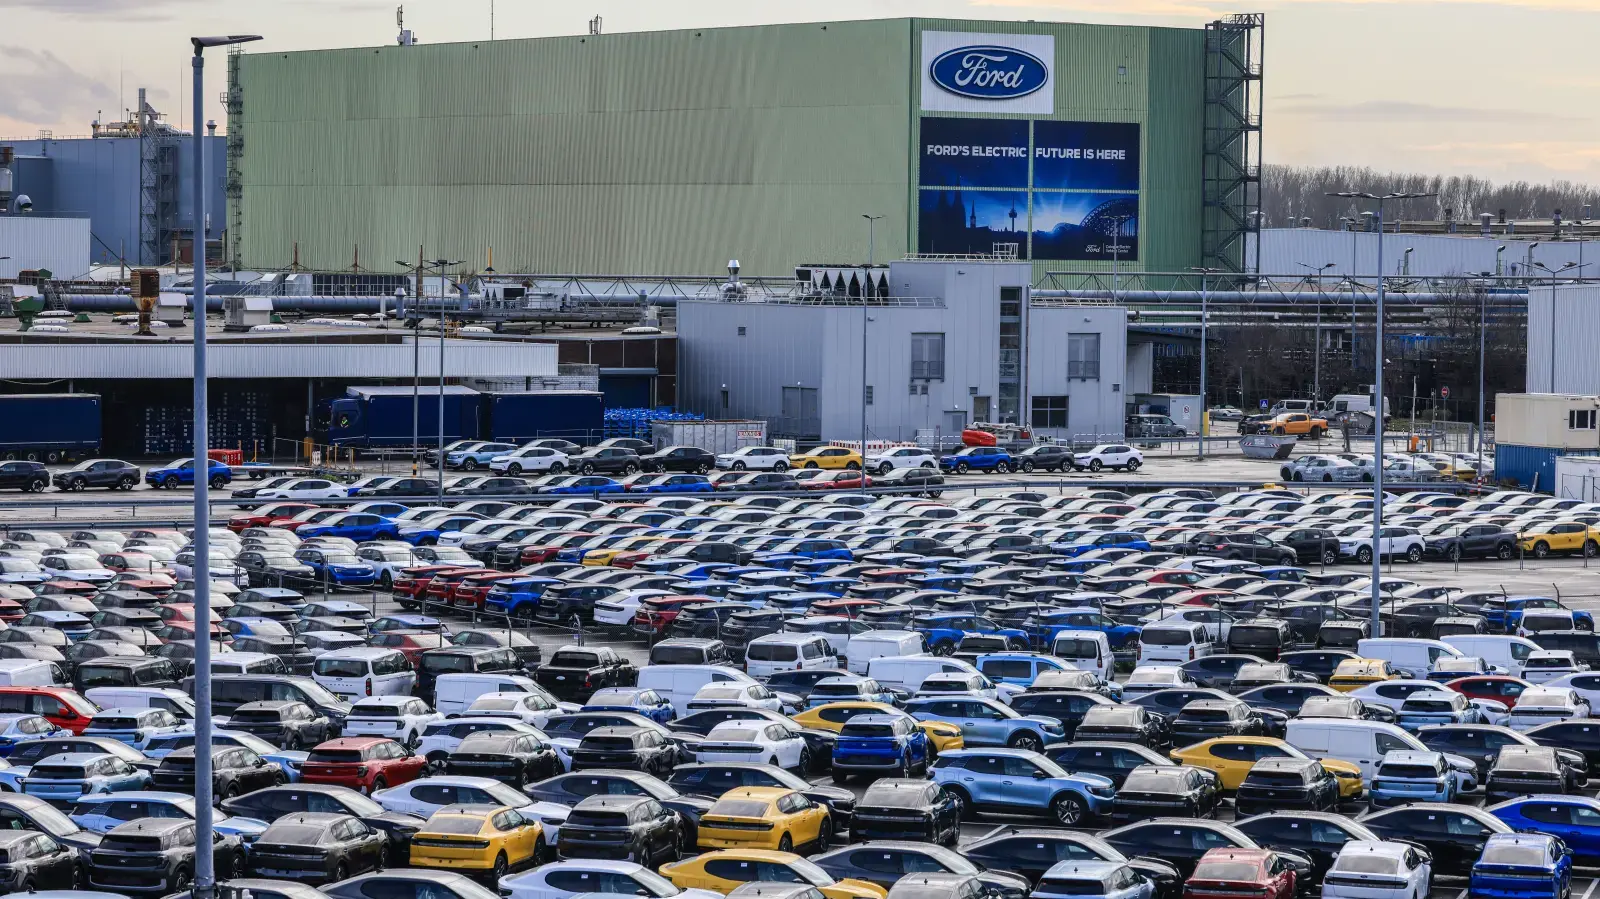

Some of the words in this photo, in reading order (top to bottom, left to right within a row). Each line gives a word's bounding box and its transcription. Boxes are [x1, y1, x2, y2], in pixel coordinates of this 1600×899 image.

[954, 53, 1025, 88] Ford
[927, 144, 970, 156] FORD'S
[971, 146, 1027, 158] ELECTRIC
[1035, 147, 1081, 159] FUTURE
[1083, 149, 1095, 160] IS
[1096, 149, 1126, 160] HERE
